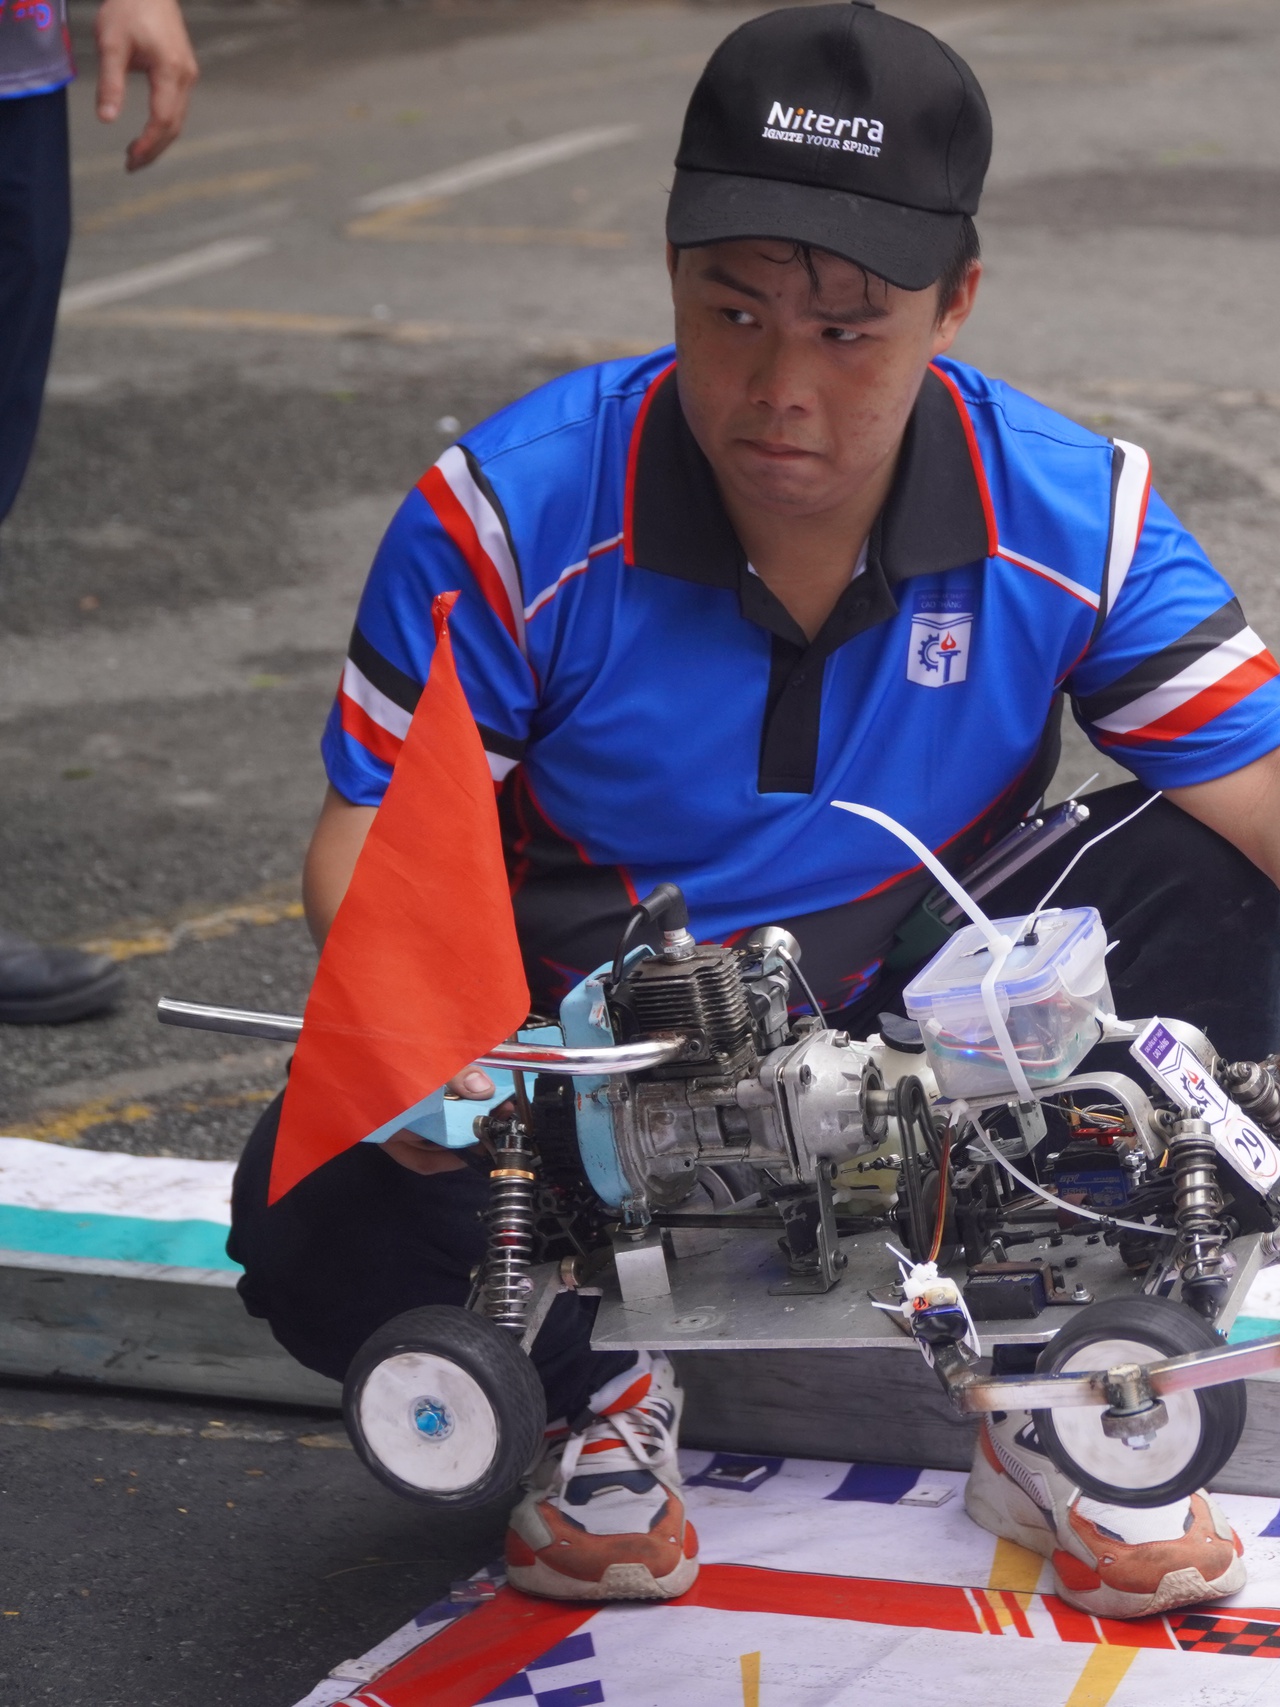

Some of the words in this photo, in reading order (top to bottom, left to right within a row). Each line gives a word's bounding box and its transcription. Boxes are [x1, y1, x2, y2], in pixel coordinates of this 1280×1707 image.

[762, 127, 804, 143] IGNITE
[806, 134, 840, 149] YOUR
[842, 139, 881, 157] SPIRIT
[766, 101, 885, 144] Niterra
[1234, 1127, 1266, 1171] 29
